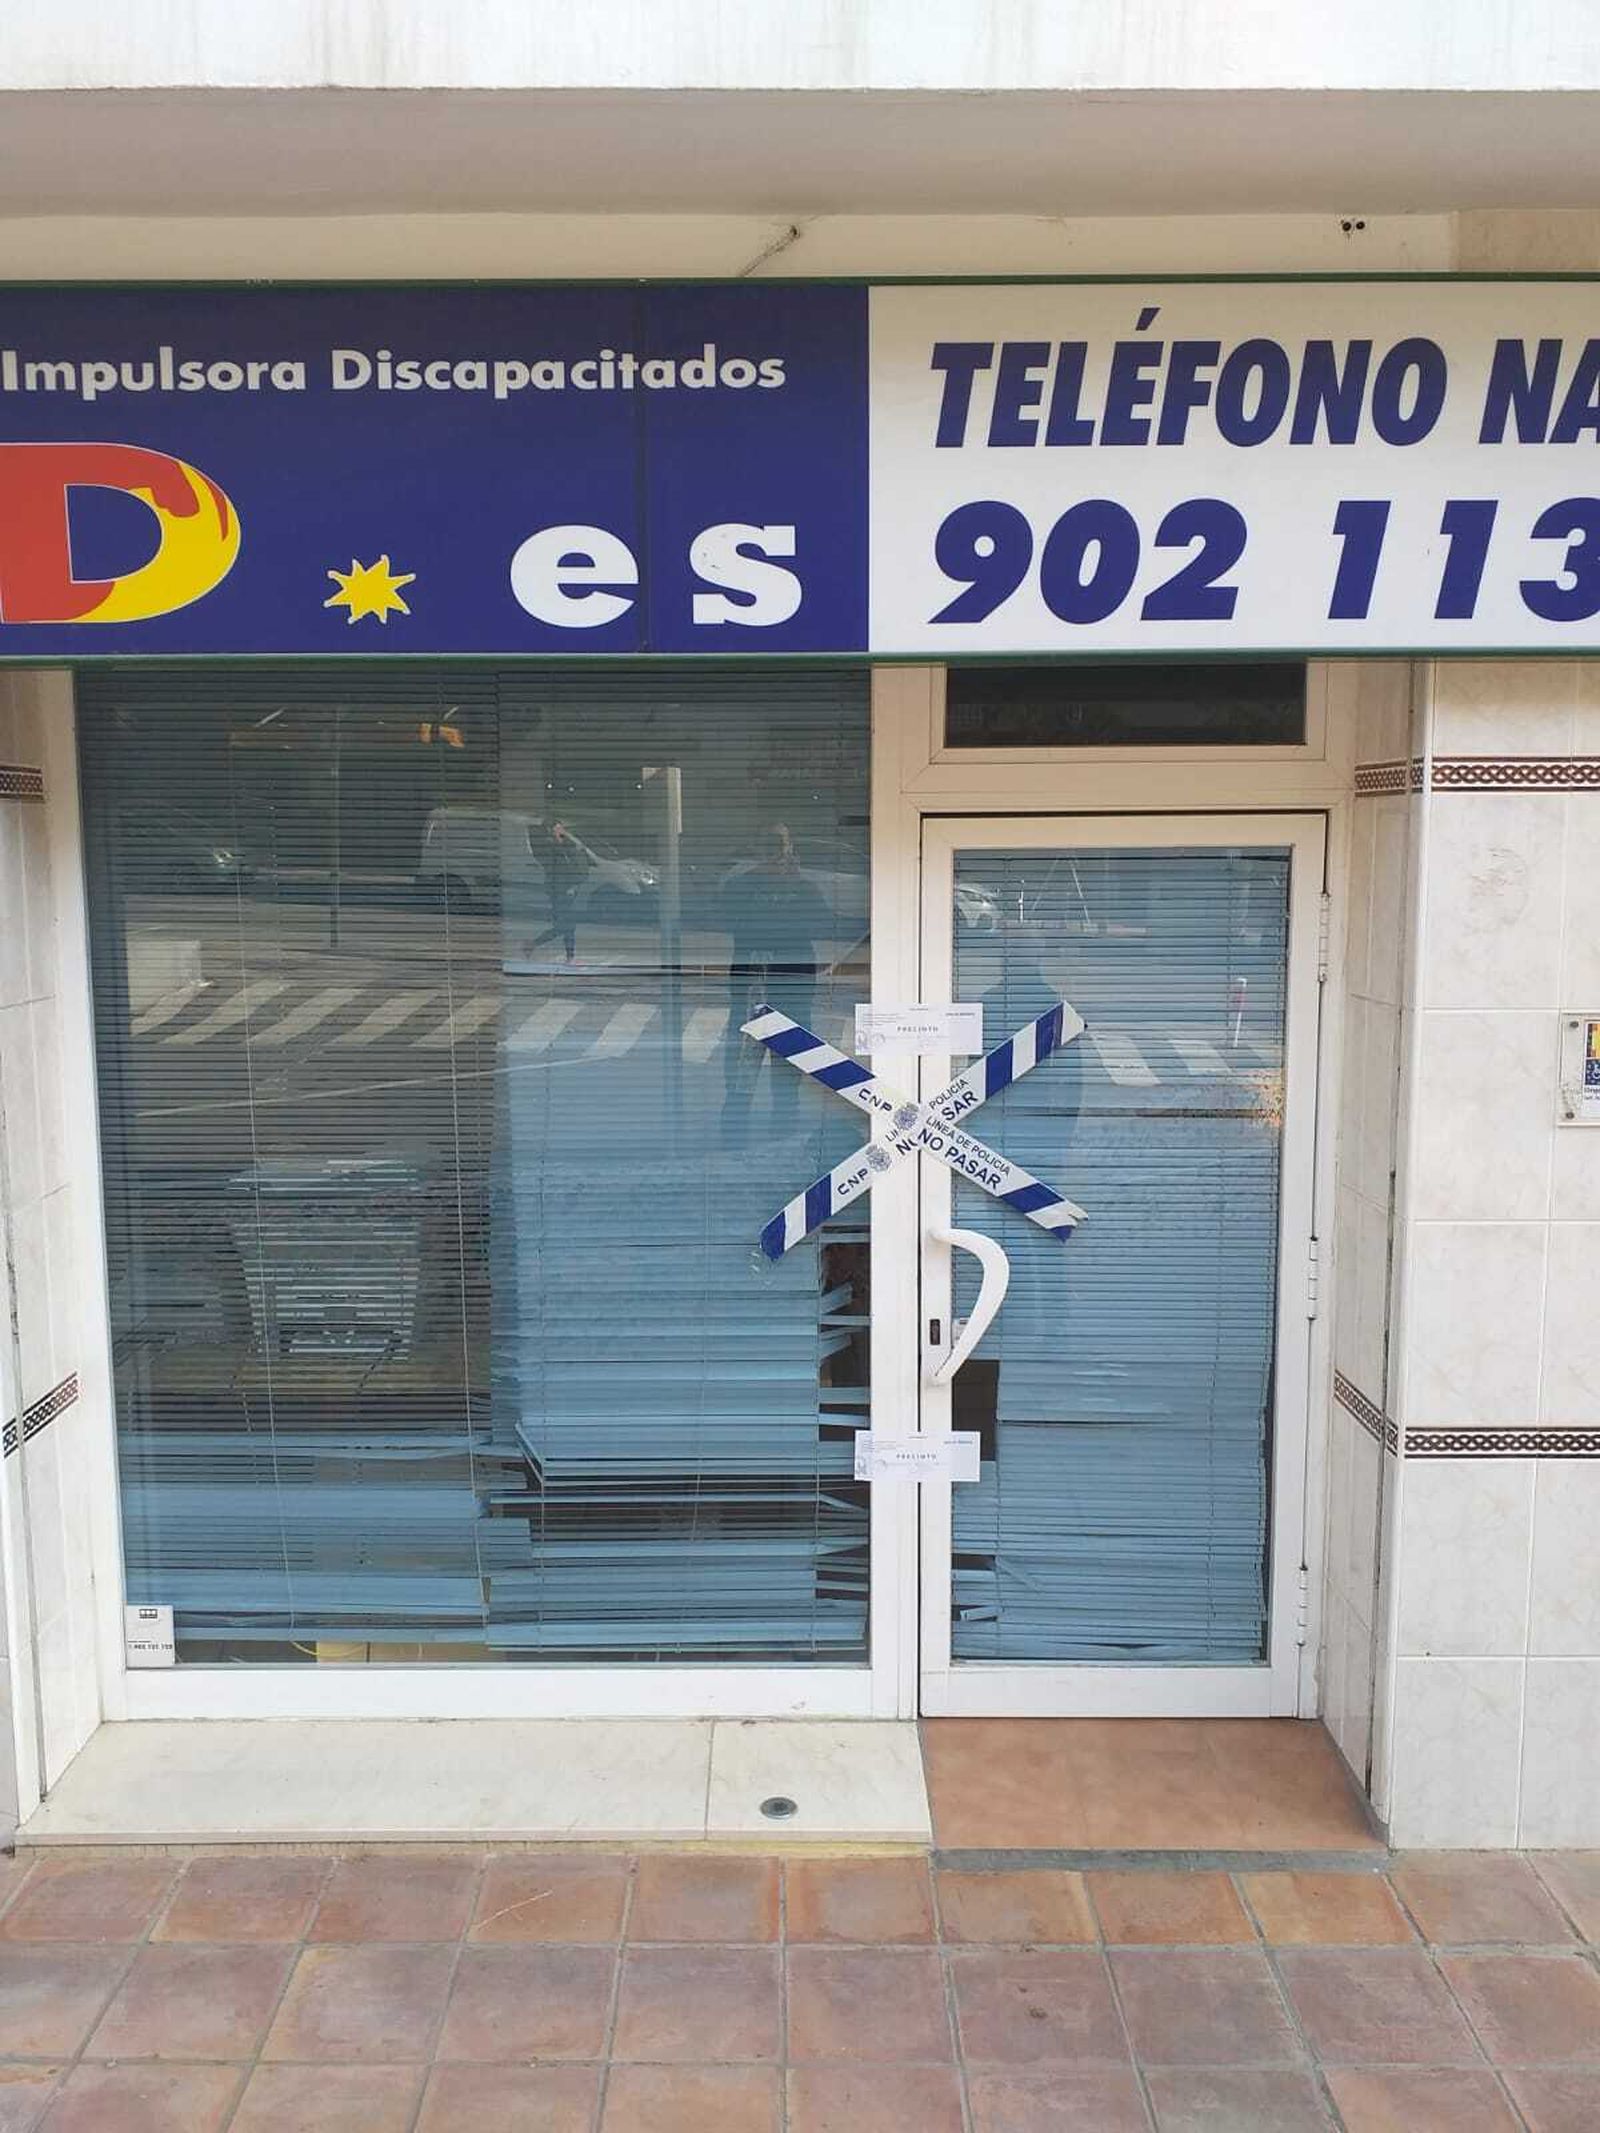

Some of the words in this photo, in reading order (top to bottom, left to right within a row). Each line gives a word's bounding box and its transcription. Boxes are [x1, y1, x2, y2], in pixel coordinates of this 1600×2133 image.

[2, 346, 306, 400] Impulsora
[331, 345, 787, 399] Discapacitados
[931, 307, 1447, 448] TELÉFONO
[928, 498, 1248, 625] 902
[858, 1088, 892, 1112] CNP
[942, 1090, 978, 1121] SAR
[918, 1128, 944, 1151] NO
[945, 1146, 1002, 1189] PASAR
[956, 1135, 972, 1149] DE
[836, 1167, 869, 1196] CNP
